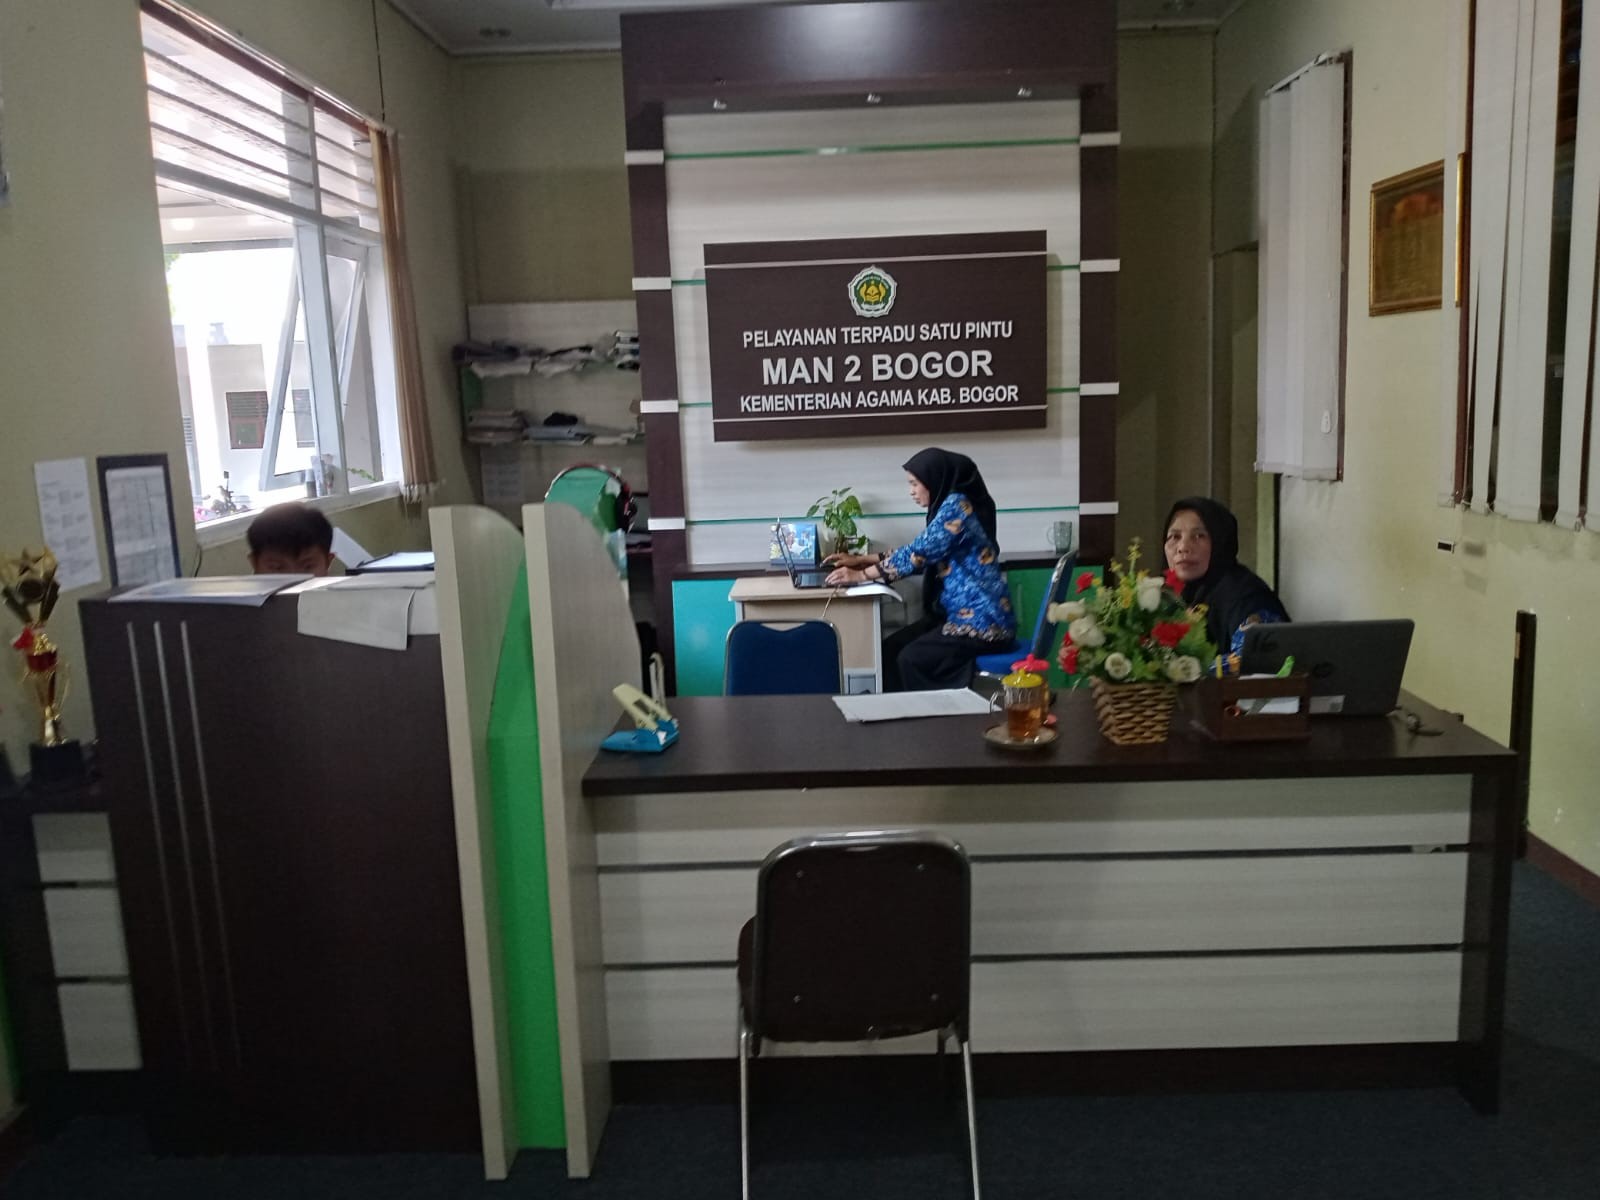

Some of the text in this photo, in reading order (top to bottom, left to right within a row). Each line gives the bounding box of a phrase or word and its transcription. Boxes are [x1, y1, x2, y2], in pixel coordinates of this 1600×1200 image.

[743, 320, 1013, 348] PELAYANAN TERPADU SATU PINTU
[762, 349, 994, 385] MAN 2 BOGOR
[740, 385, 1019, 412] KEMENTERIAN AGAMA KAB. BOGOR
